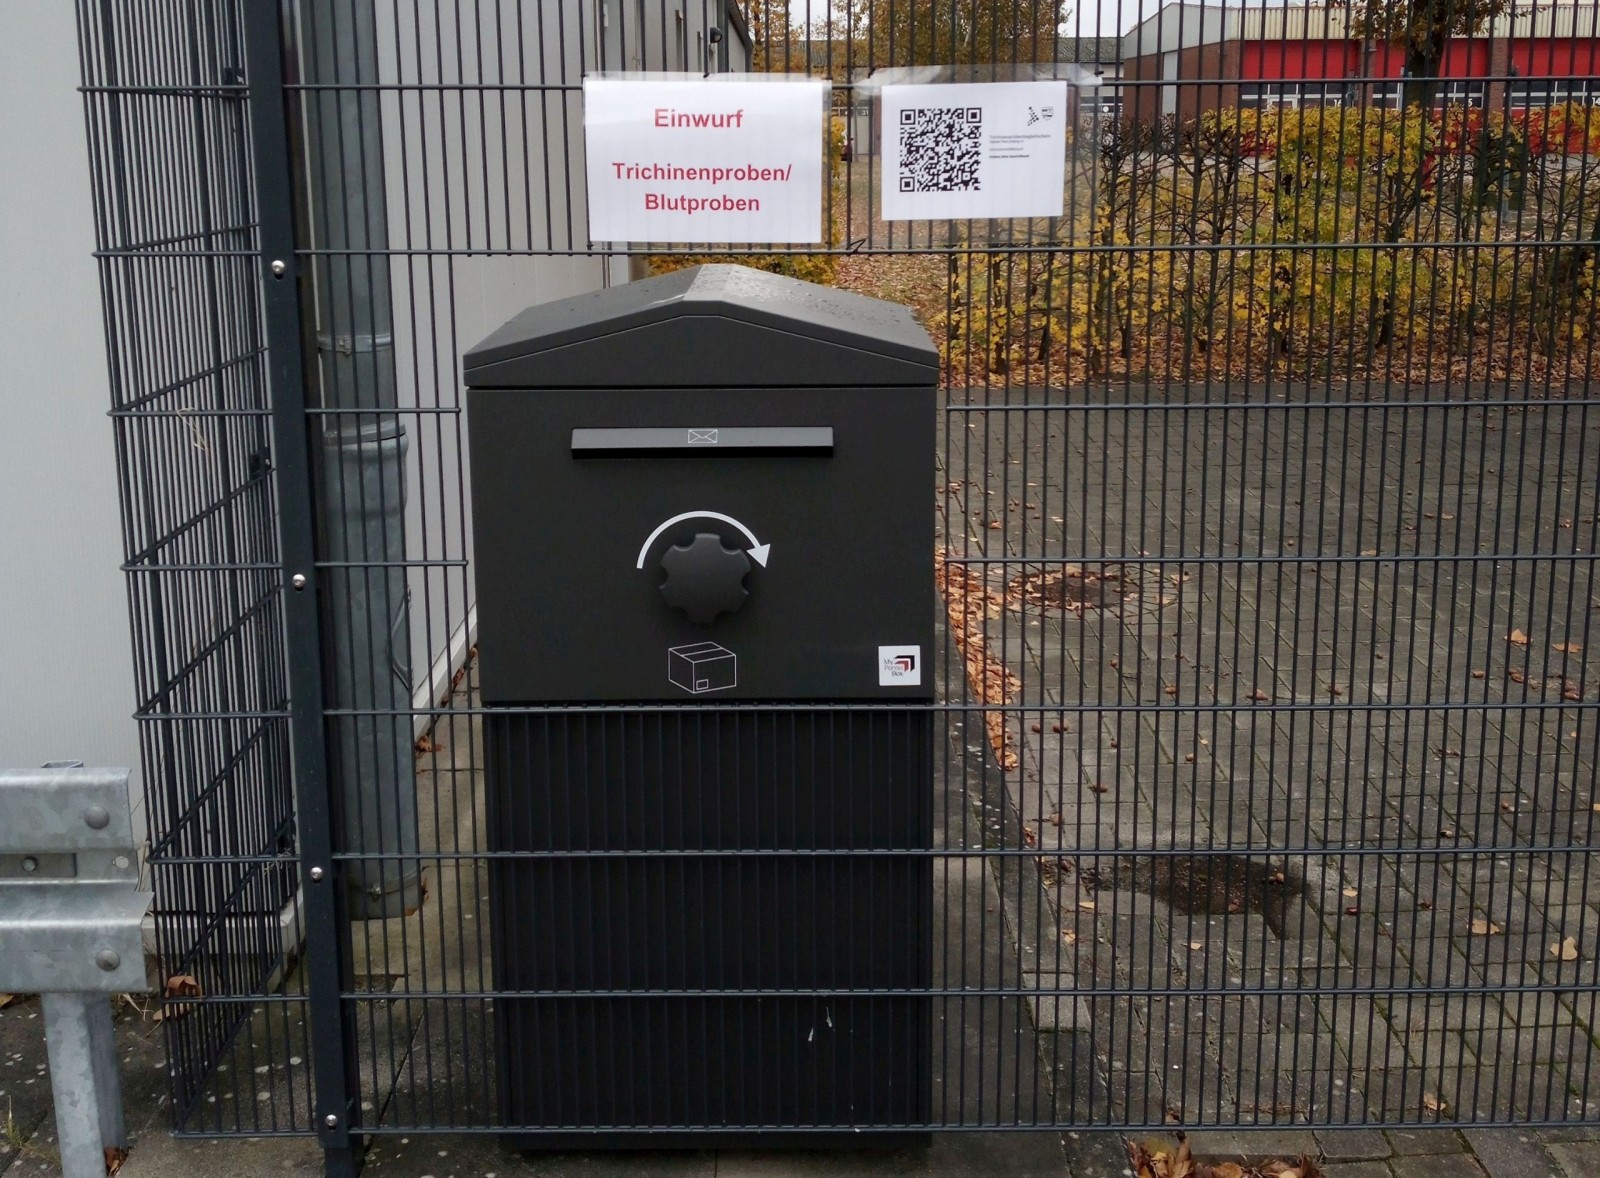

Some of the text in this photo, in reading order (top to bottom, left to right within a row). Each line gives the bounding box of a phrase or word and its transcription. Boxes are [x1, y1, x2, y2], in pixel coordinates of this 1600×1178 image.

[1334, 99, 1342, 107] 16
[1592, 97, 1600, 106] 14
[655, 108, 743, 128] Einwurf
[612, 162, 792, 184] Trichinenproben/
[645, 193, 760, 214] Blutproben
